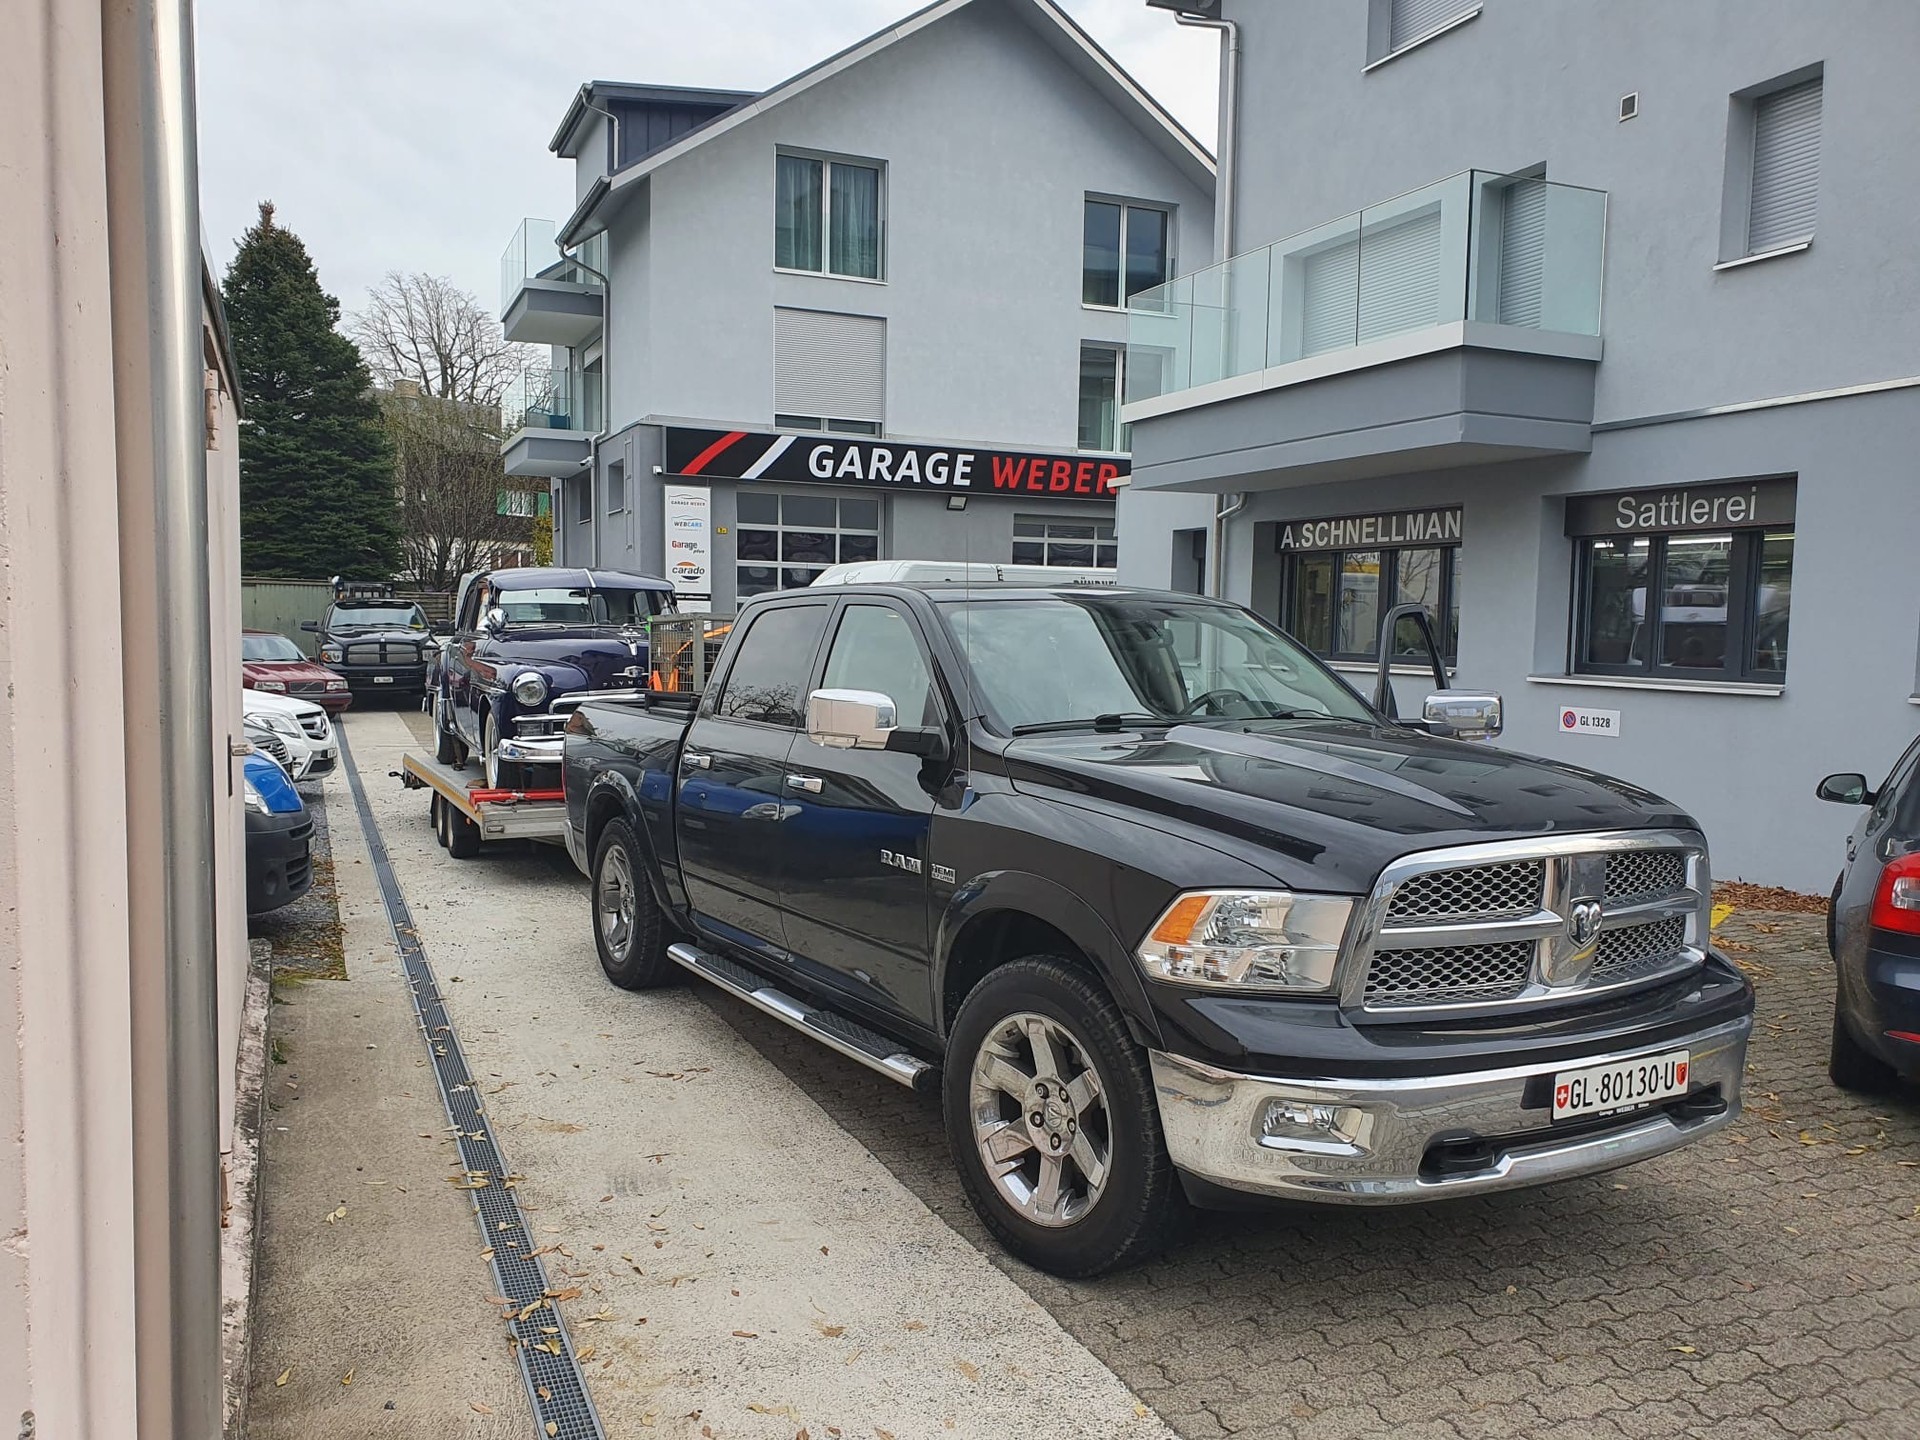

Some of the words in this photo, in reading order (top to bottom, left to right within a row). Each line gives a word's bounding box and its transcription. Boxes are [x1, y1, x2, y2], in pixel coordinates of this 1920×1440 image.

[808, 444, 975, 486] GARAGE
[992, 456, 1118, 494] WEBER
[1615, 486, 1757, 529] Sattlerei
[1280, 510, 1461, 549] A.SCHNELLMAN
[672, 540, 698, 551] Garage
[672, 566, 705, 575] carado
[1580, 715, 1591, 727] GL
[1592, 717, 1611, 729] 1328
[880, 849, 922, 874] RAM
